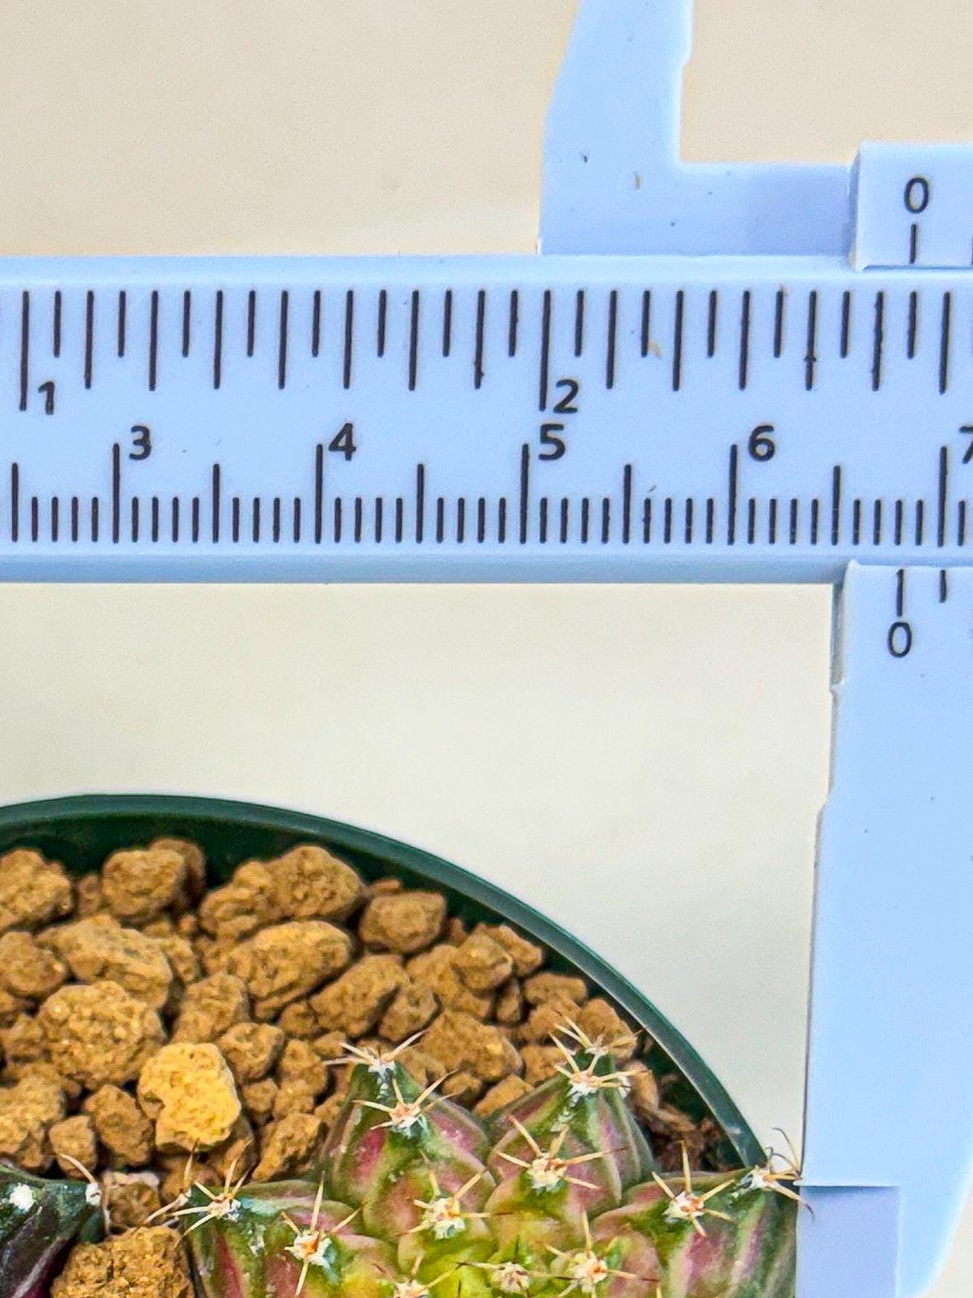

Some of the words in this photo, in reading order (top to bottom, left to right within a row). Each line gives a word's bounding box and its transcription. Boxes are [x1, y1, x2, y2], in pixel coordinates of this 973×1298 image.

[903, 176, 930, 214] 0
[37, 380, 56, 415] 1
[552, 378, 579, 414] 2
[128, 424, 152, 461] 3
[327, 422, 357, 462] 4
[538, 423, 567, 462] 5
[747, 424, 776, 463] 6
[887, 621, 913, 659] 0
